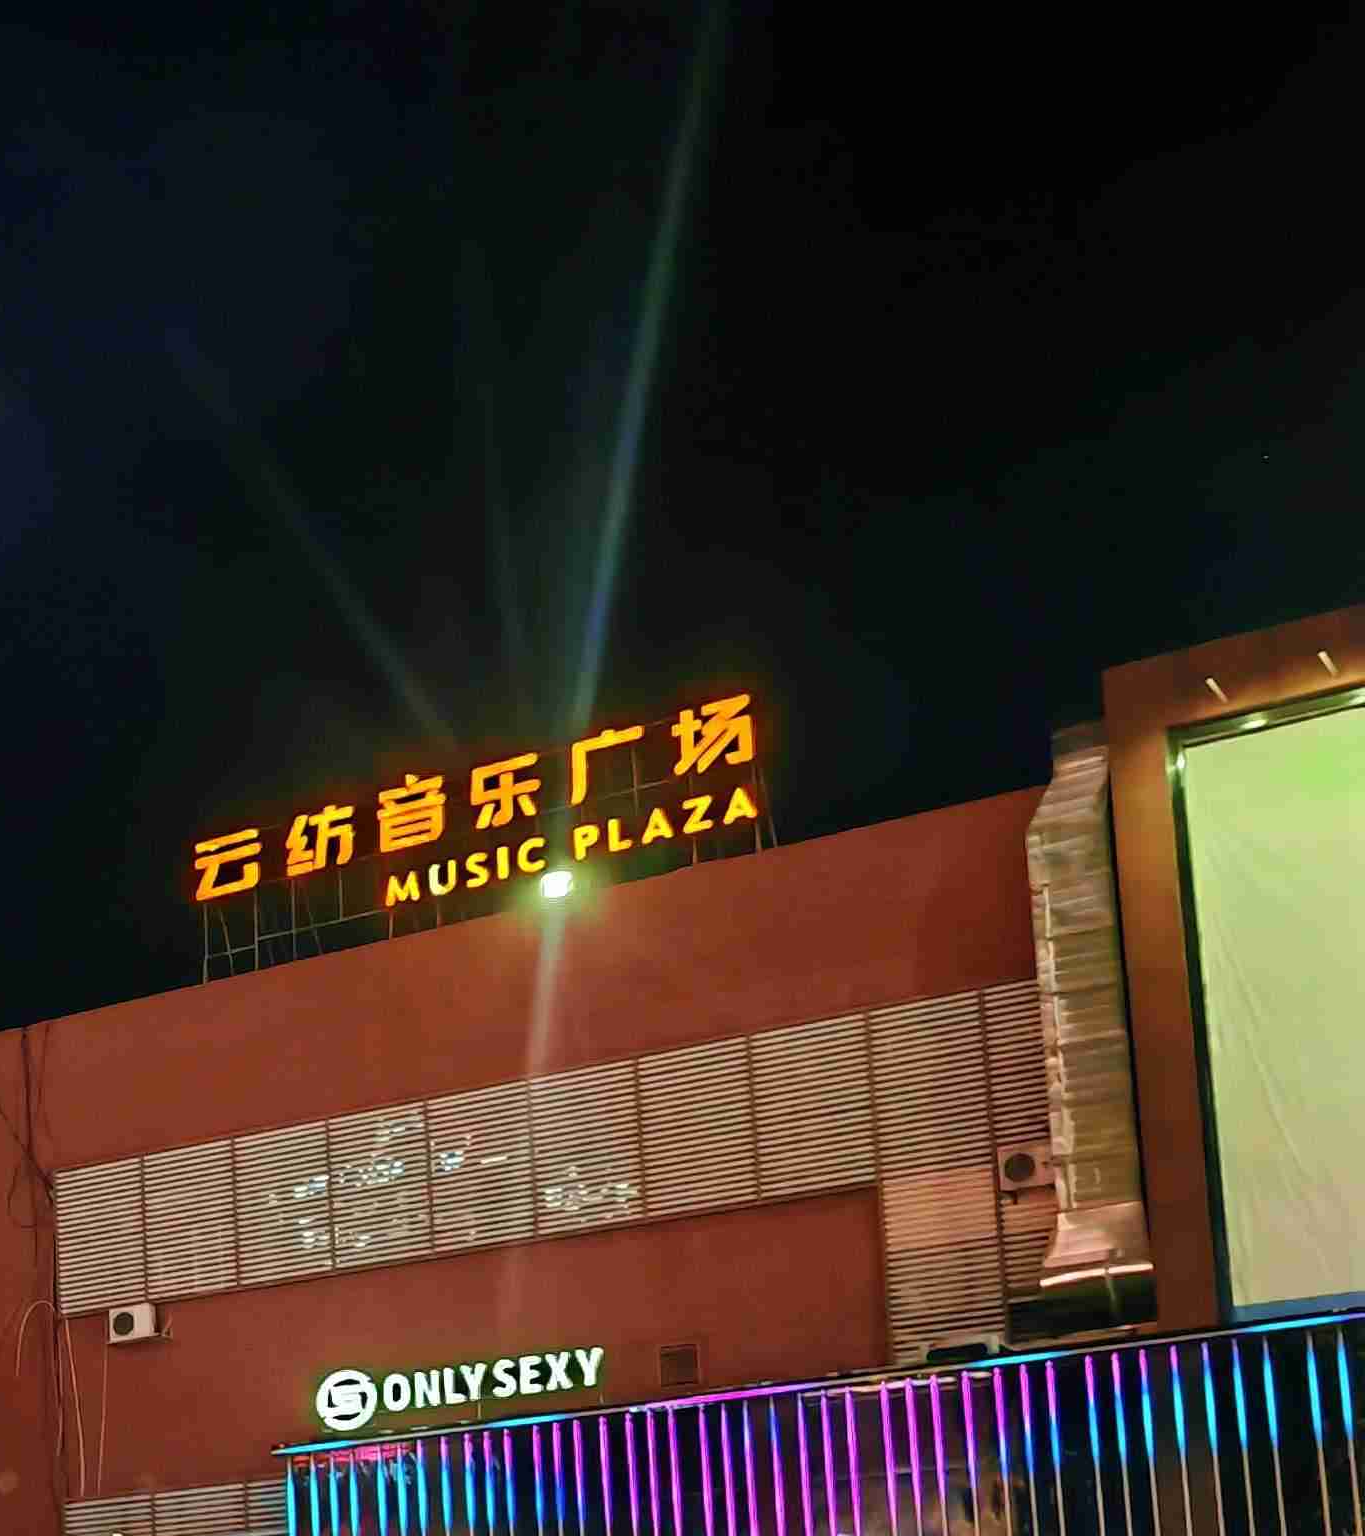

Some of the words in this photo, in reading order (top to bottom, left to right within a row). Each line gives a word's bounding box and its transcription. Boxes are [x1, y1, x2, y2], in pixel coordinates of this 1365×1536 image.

[194, 694, 755, 902] 云纺音乐广场
[386, 836, 548, 907] MUSIC
[573, 787, 759, 862] PLAZA
